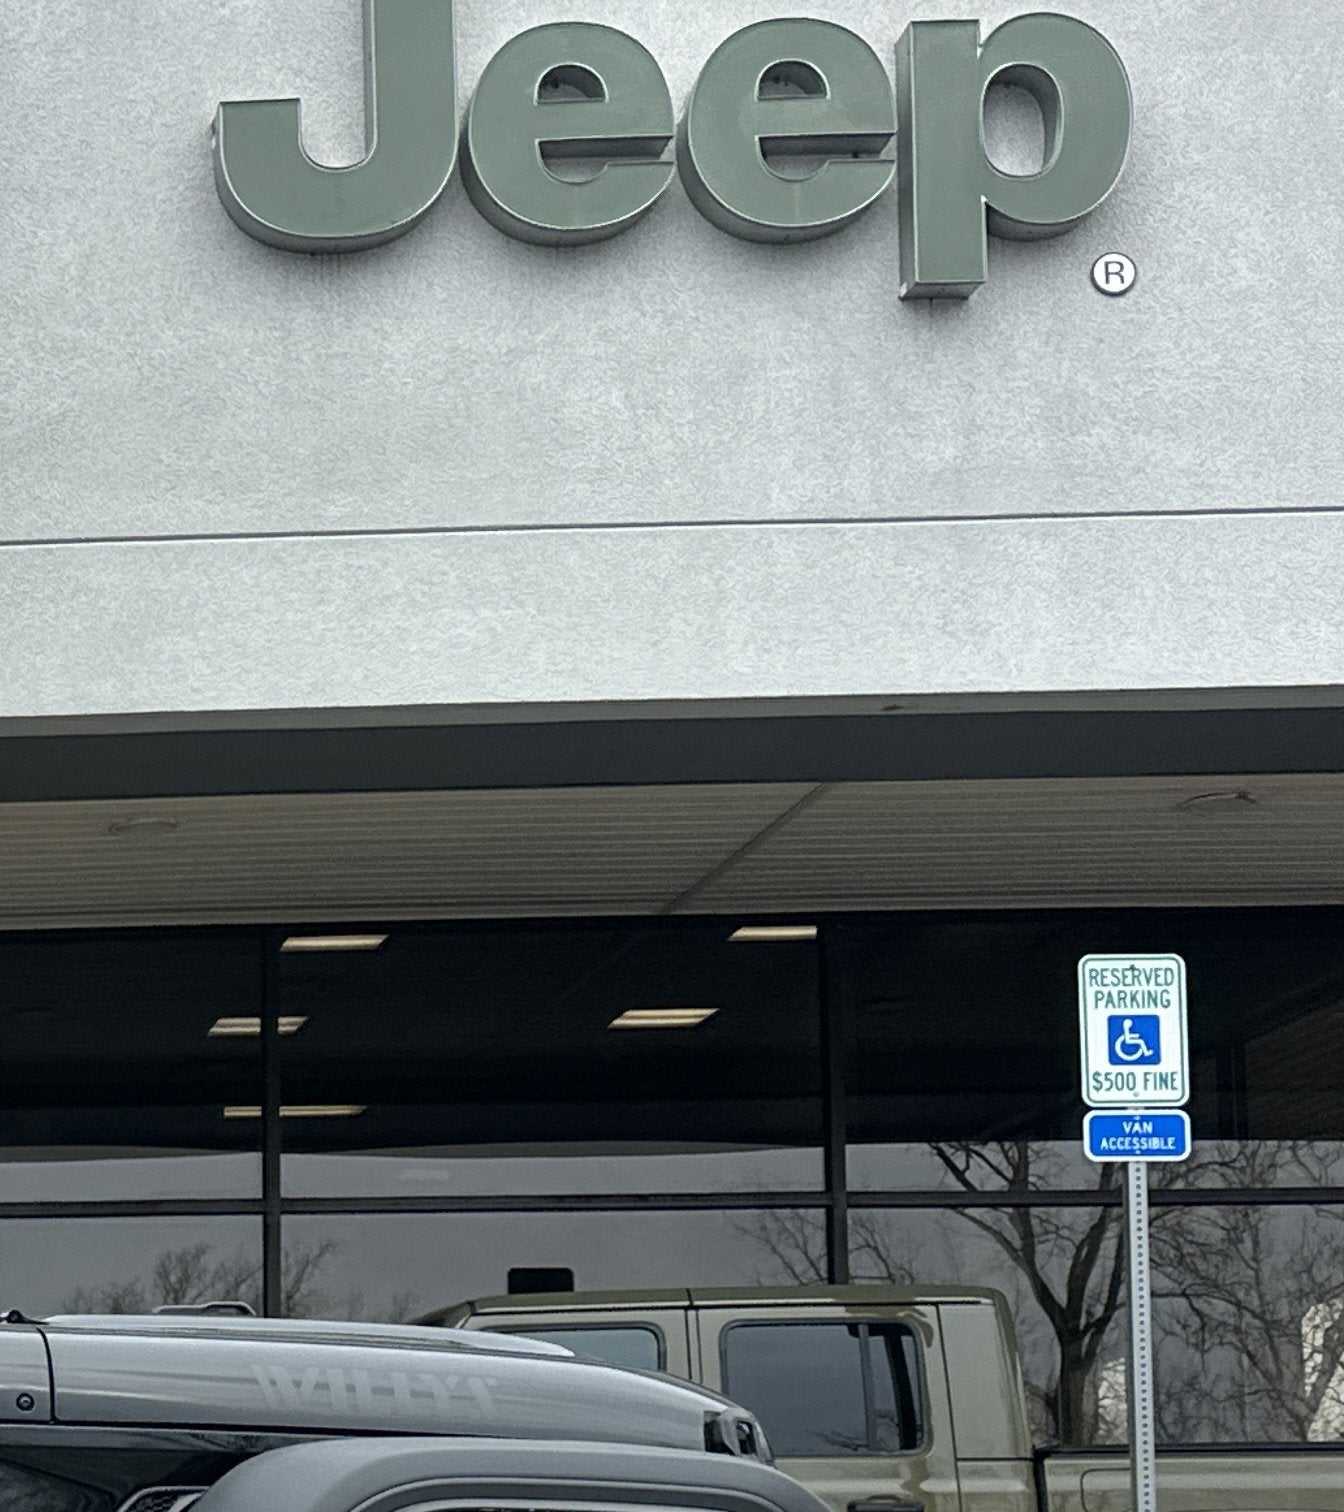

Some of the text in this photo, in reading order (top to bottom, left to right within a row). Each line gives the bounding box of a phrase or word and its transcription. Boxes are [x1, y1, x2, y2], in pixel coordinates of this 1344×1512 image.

[214, 0, 1134, 299] Jeep
[1088, 967, 1175, 987] RESERVED
[1094, 990, 1172, 1009] PARKING
[1092, 1071, 1179, 1092] $500 FINE
[1122, 1121, 1153, 1135] VAN
[1100, 1136, 1176, 1150] ACCESSIBLE
